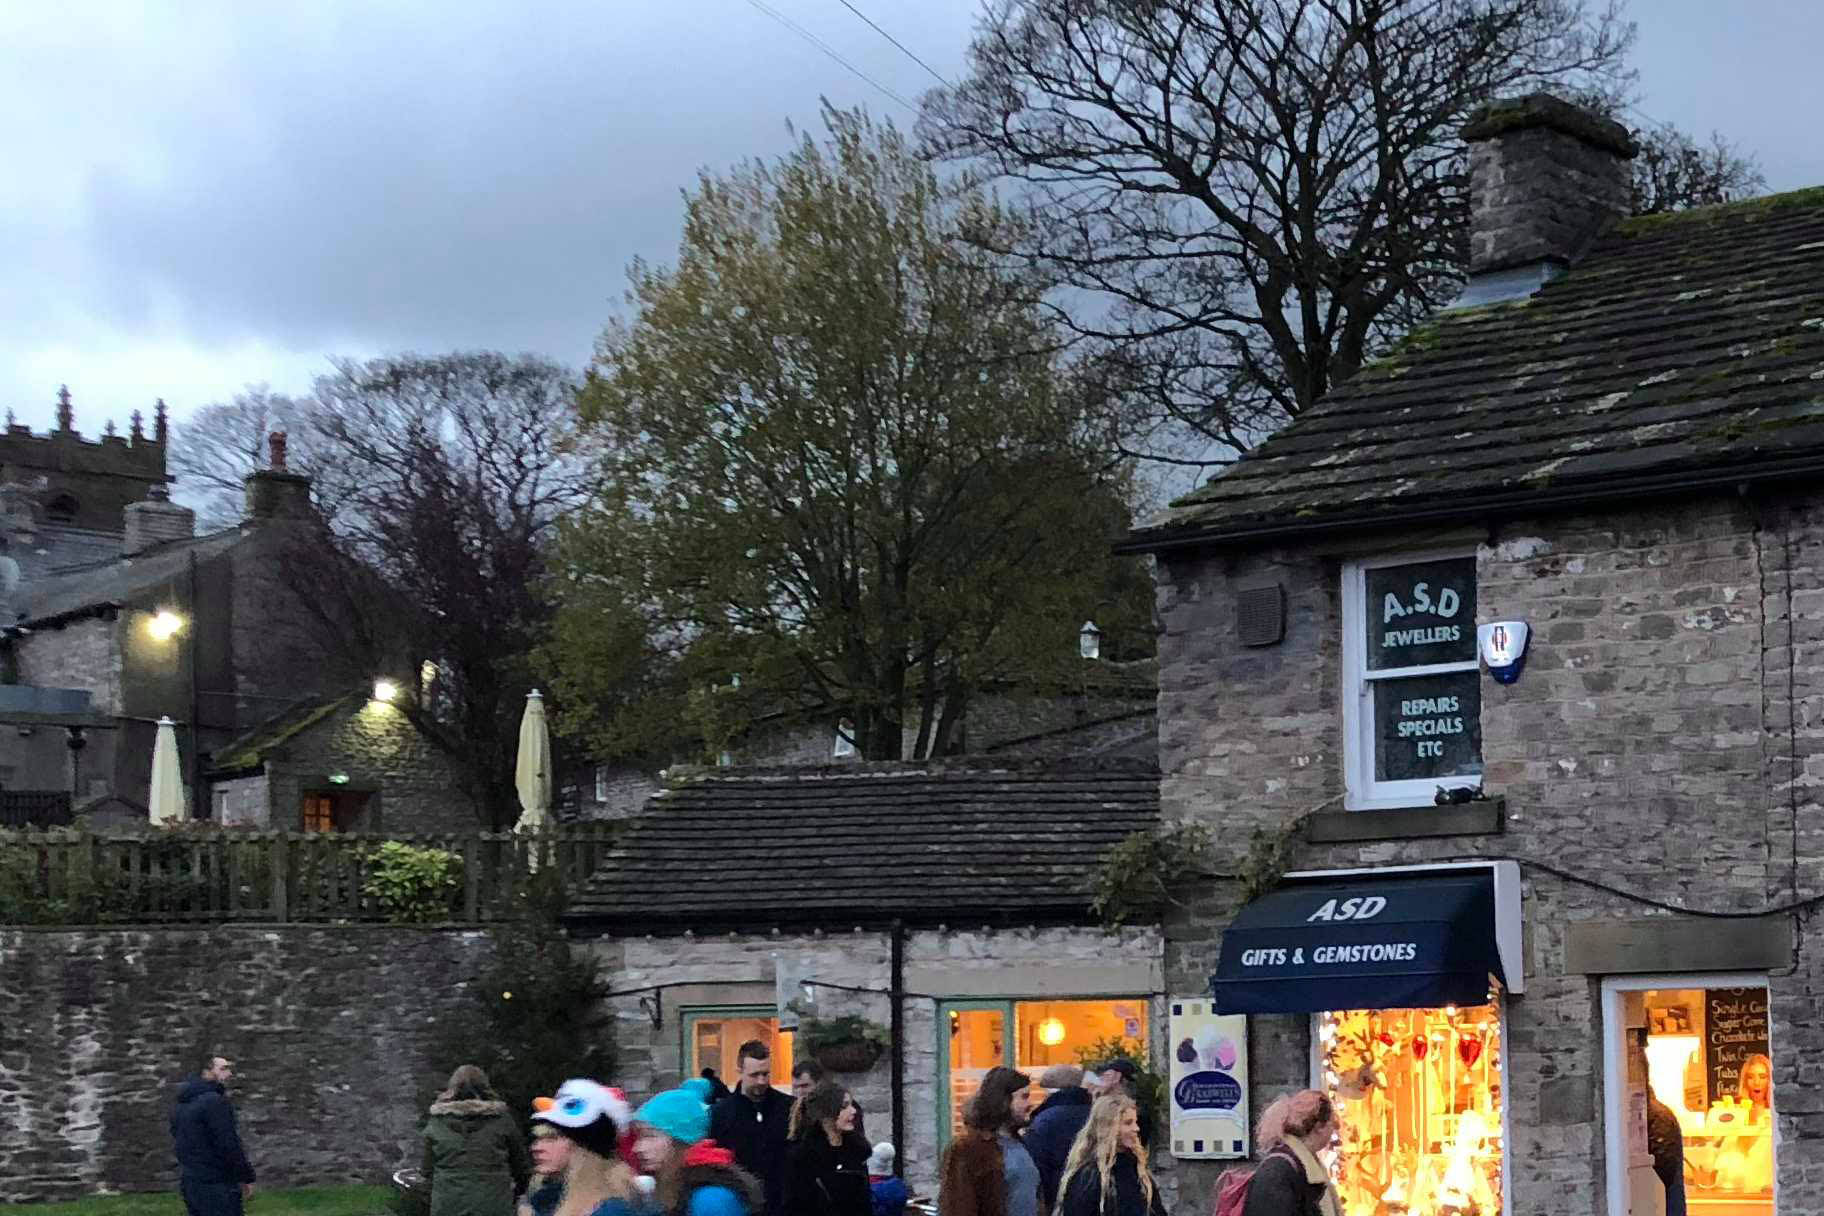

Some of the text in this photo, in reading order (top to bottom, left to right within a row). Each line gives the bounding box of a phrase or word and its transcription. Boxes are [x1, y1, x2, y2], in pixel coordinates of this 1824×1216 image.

[1383, 581, 1460, 624] A.S.D
[1382, 625, 1461, 648] JEWELLERS
[1401, 696, 1460, 716] REPAIRS
[1398, 717, 1464, 737] SPECIALS
[1417, 741, 1444, 758] ETC
[1306, 896, 1387, 922] ASD
[1241, 943, 1417, 966] GIFTS & GEMSTONES
